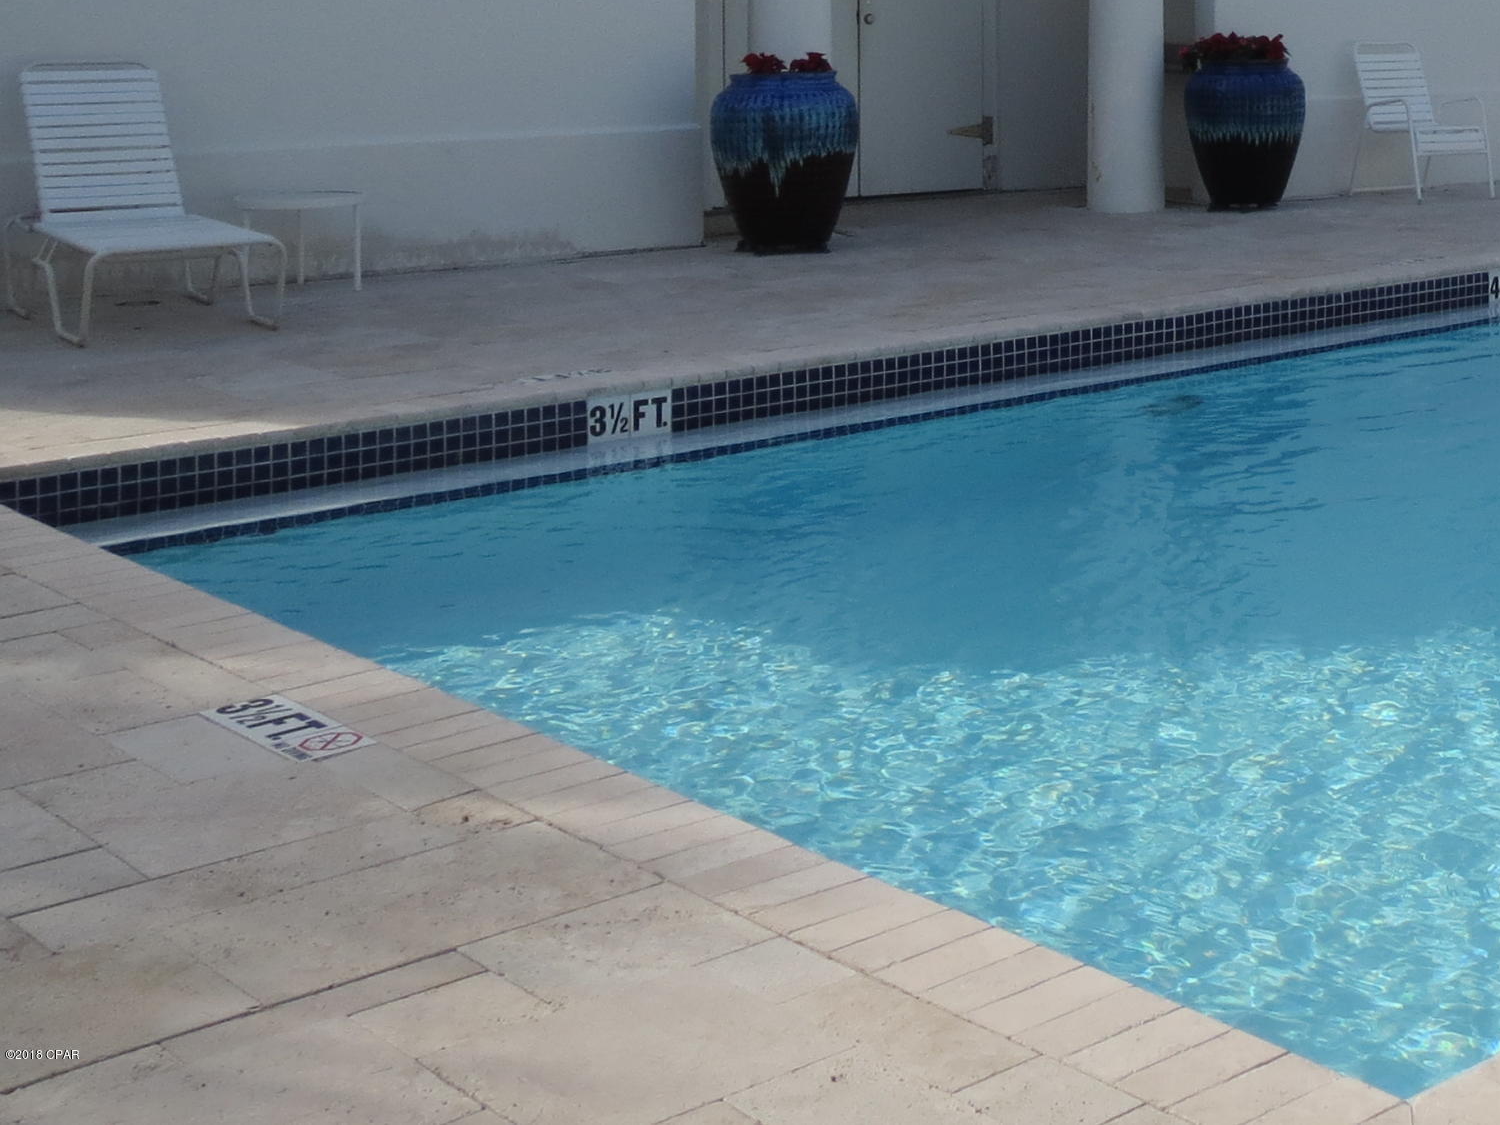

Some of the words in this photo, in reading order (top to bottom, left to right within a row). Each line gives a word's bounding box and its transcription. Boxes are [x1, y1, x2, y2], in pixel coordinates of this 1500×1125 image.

[589, 402, 629, 437] 3½
[632, 396, 668, 431] FT.
[216, 698, 293, 725] 3½
